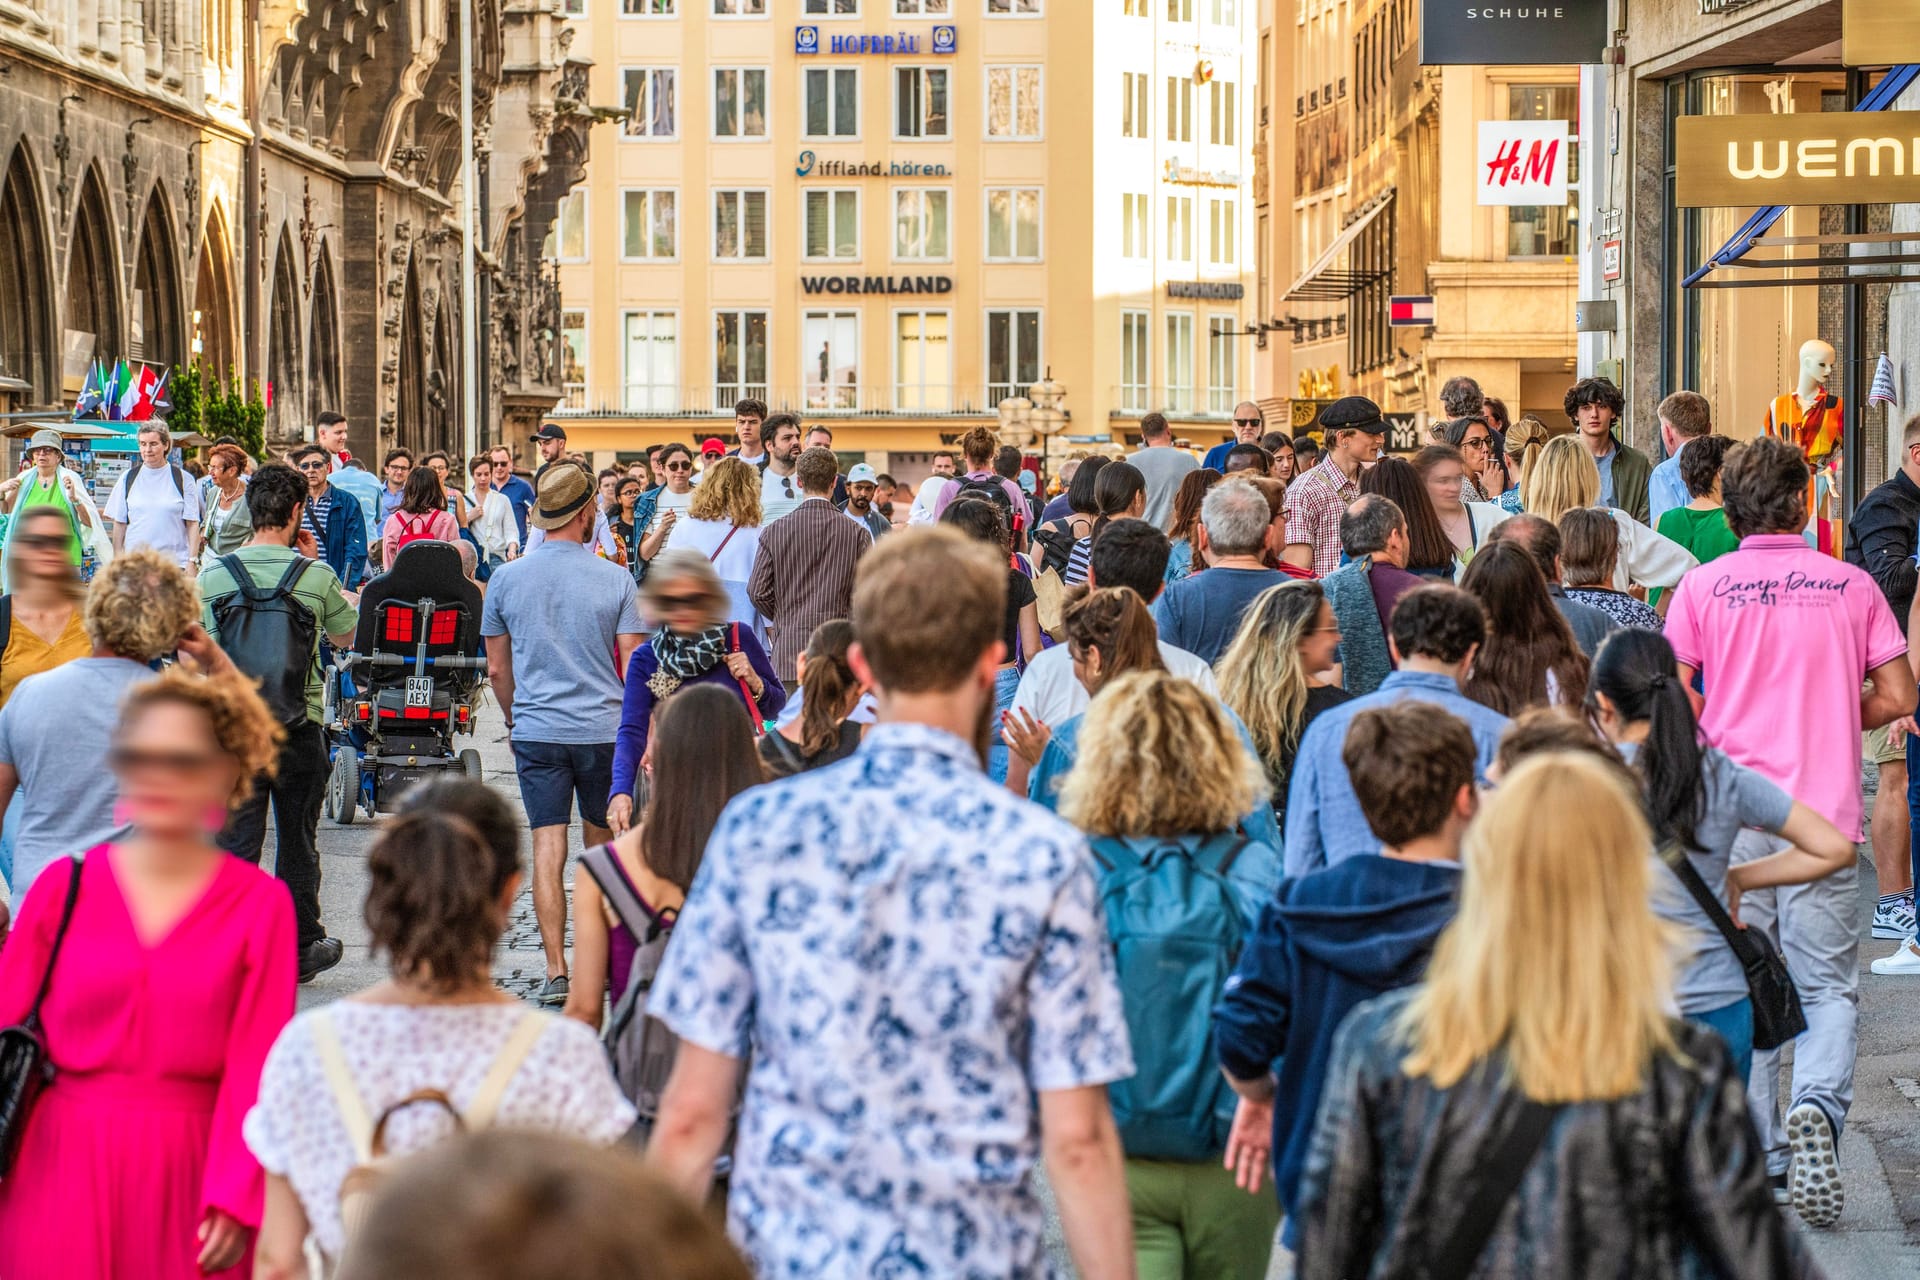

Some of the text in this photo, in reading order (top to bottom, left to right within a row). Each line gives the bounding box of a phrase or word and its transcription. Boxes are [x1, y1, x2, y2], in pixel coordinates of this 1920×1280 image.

[1466, 7, 1564, 19] SCHUHE
[831, 32, 920, 54] HOFBRÄU
[1486, 138, 1560, 187] H&M
[800, 276, 953, 295] WORMLAND
[1713, 570, 1850, 598] Camp David
[409, 679, 429, 691] 840
[409, 692, 428, 705] AEX
